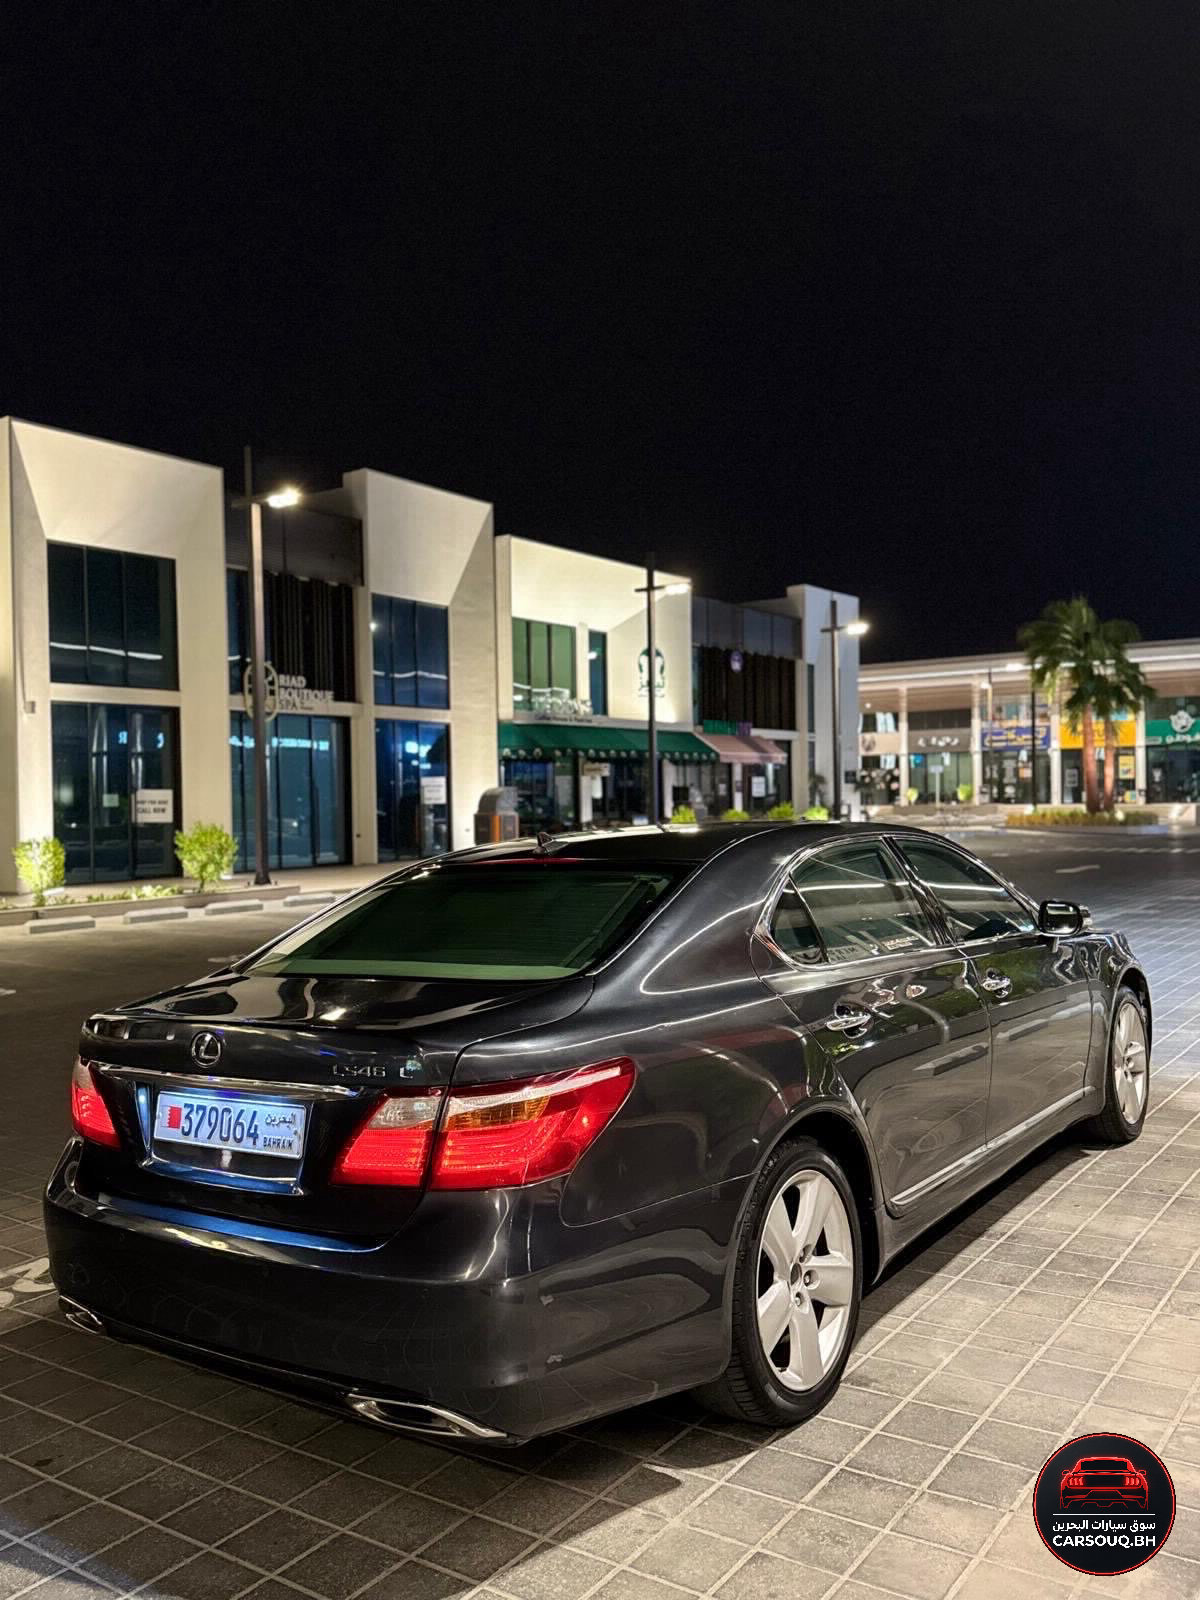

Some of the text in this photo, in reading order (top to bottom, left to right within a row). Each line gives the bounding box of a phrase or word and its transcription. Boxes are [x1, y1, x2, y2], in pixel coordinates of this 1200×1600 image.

[279, 674, 306, 688] RIAD
[279, 688, 334, 703] BOUTIQUE
[279, 700, 298, 711] SPA
[181, 1103, 260, 1146] 379064
[264, 1112, 297, 1130] البحرين
[263, 1136, 294, 1150] BAHRAIN
